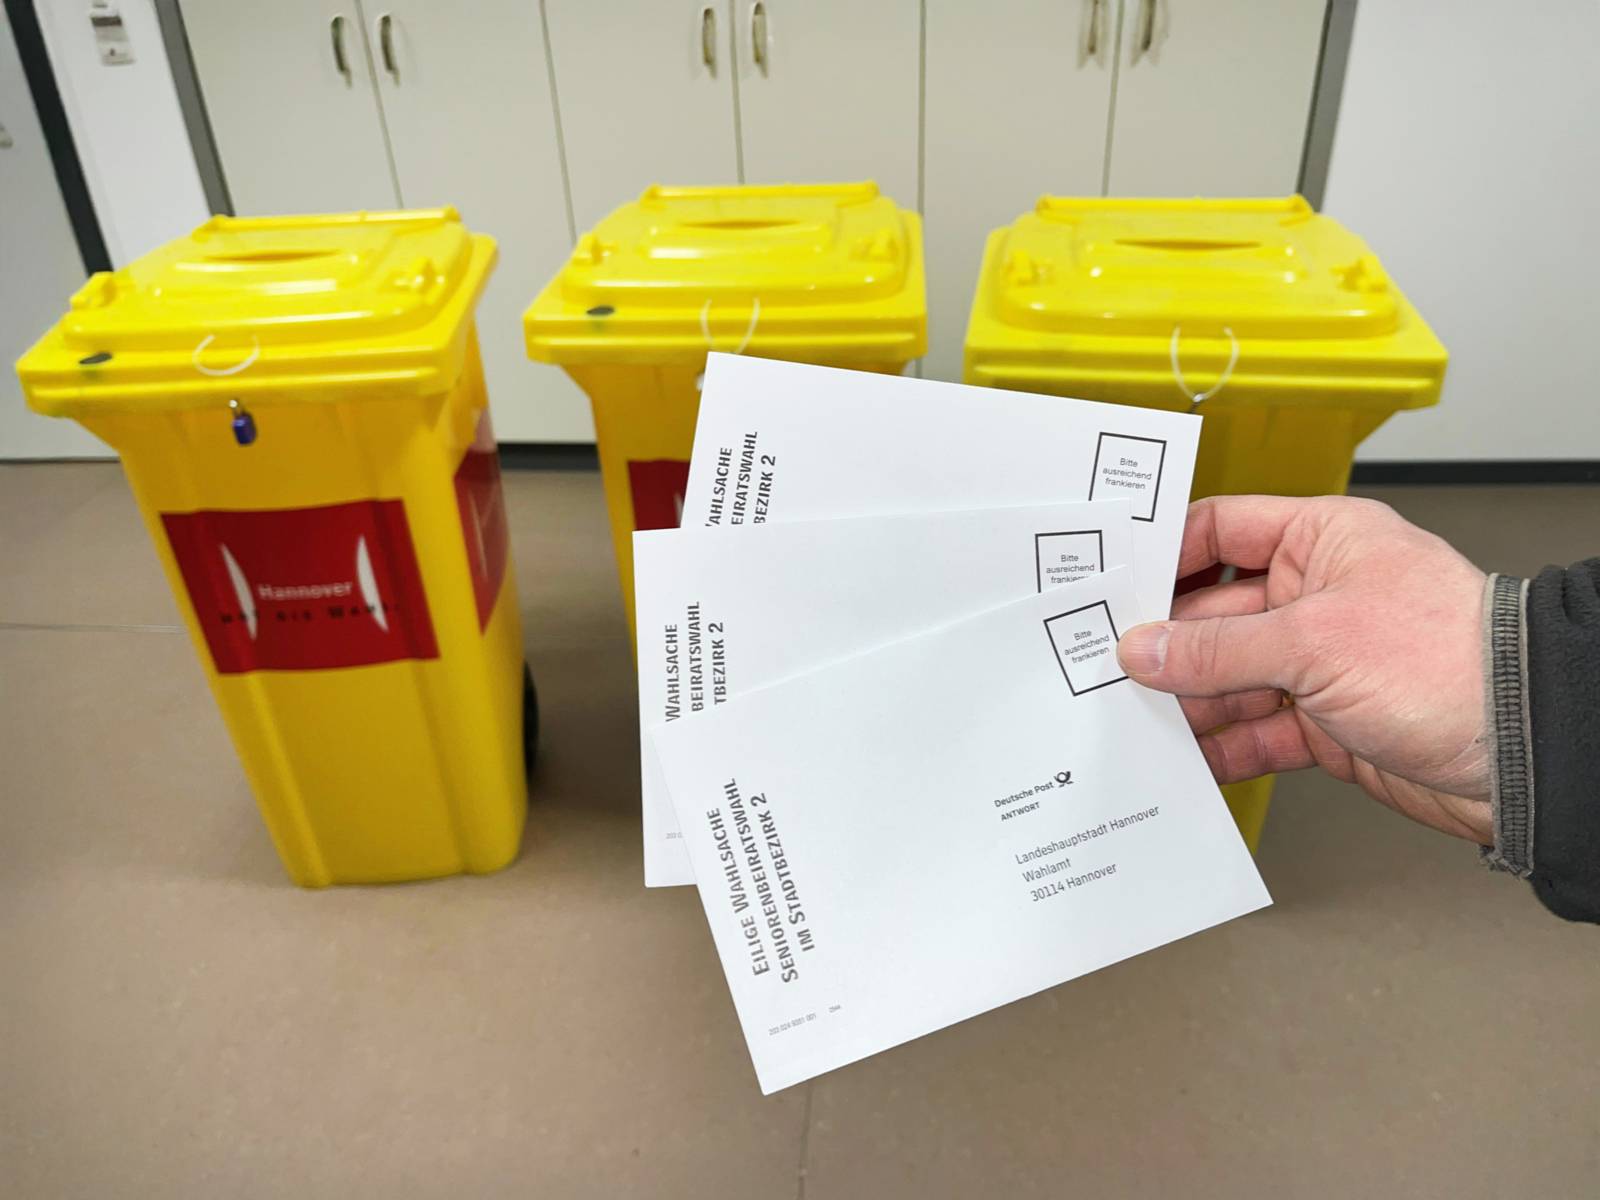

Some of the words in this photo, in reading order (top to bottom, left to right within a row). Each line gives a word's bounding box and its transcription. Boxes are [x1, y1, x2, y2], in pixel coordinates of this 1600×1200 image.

[761, 455, 776, 466] 2
[1119, 457, 1139, 468] Bitte
[1102, 466, 1153, 481] ausreichend
[1104, 477, 1146, 490] frankieren
[705, 447, 732, 527] AHLSACHE
[753, 471, 773, 524] BEZIRK
[1046, 563, 1095, 574] ausreichend
[1060, 554, 1079, 562] Bitte
[257, 581, 353, 600] Hannover
[708, 622, 724, 633] 2
[1073, 629, 1093, 641] Bitte
[687, 601, 704, 712] BEIRATSWAHL
[1064, 633, 1111, 656] ausreichend
[1071, 646, 1111, 665] frankieren
[665, 623, 681, 722] WAHLSACHE
[711, 638, 727, 705] TBEZIRK
[750, 792, 768, 807] 2
[994, 788, 1034, 808] Deutsche
[1034, 781, 1055, 795] Post
[1000, 801, 1041, 821] ANTWORT
[1015, 823, 1109, 865] Landeshauptstadt
[1109, 805, 1160, 831] Hannover
[706, 807, 749, 914] WAHLSACHE
[757, 809, 806, 925] STADTBEZIRK
[1022, 857, 1072, 883] Wahlamt
[723, 778, 799, 983] SENIORENBEIRATSWAHL
[1030, 881, 1065, 902] 30114
[1066, 863, 1118, 889] Hannover
[741, 915, 770, 976] EILIGE
[796, 928, 816, 952] IM
